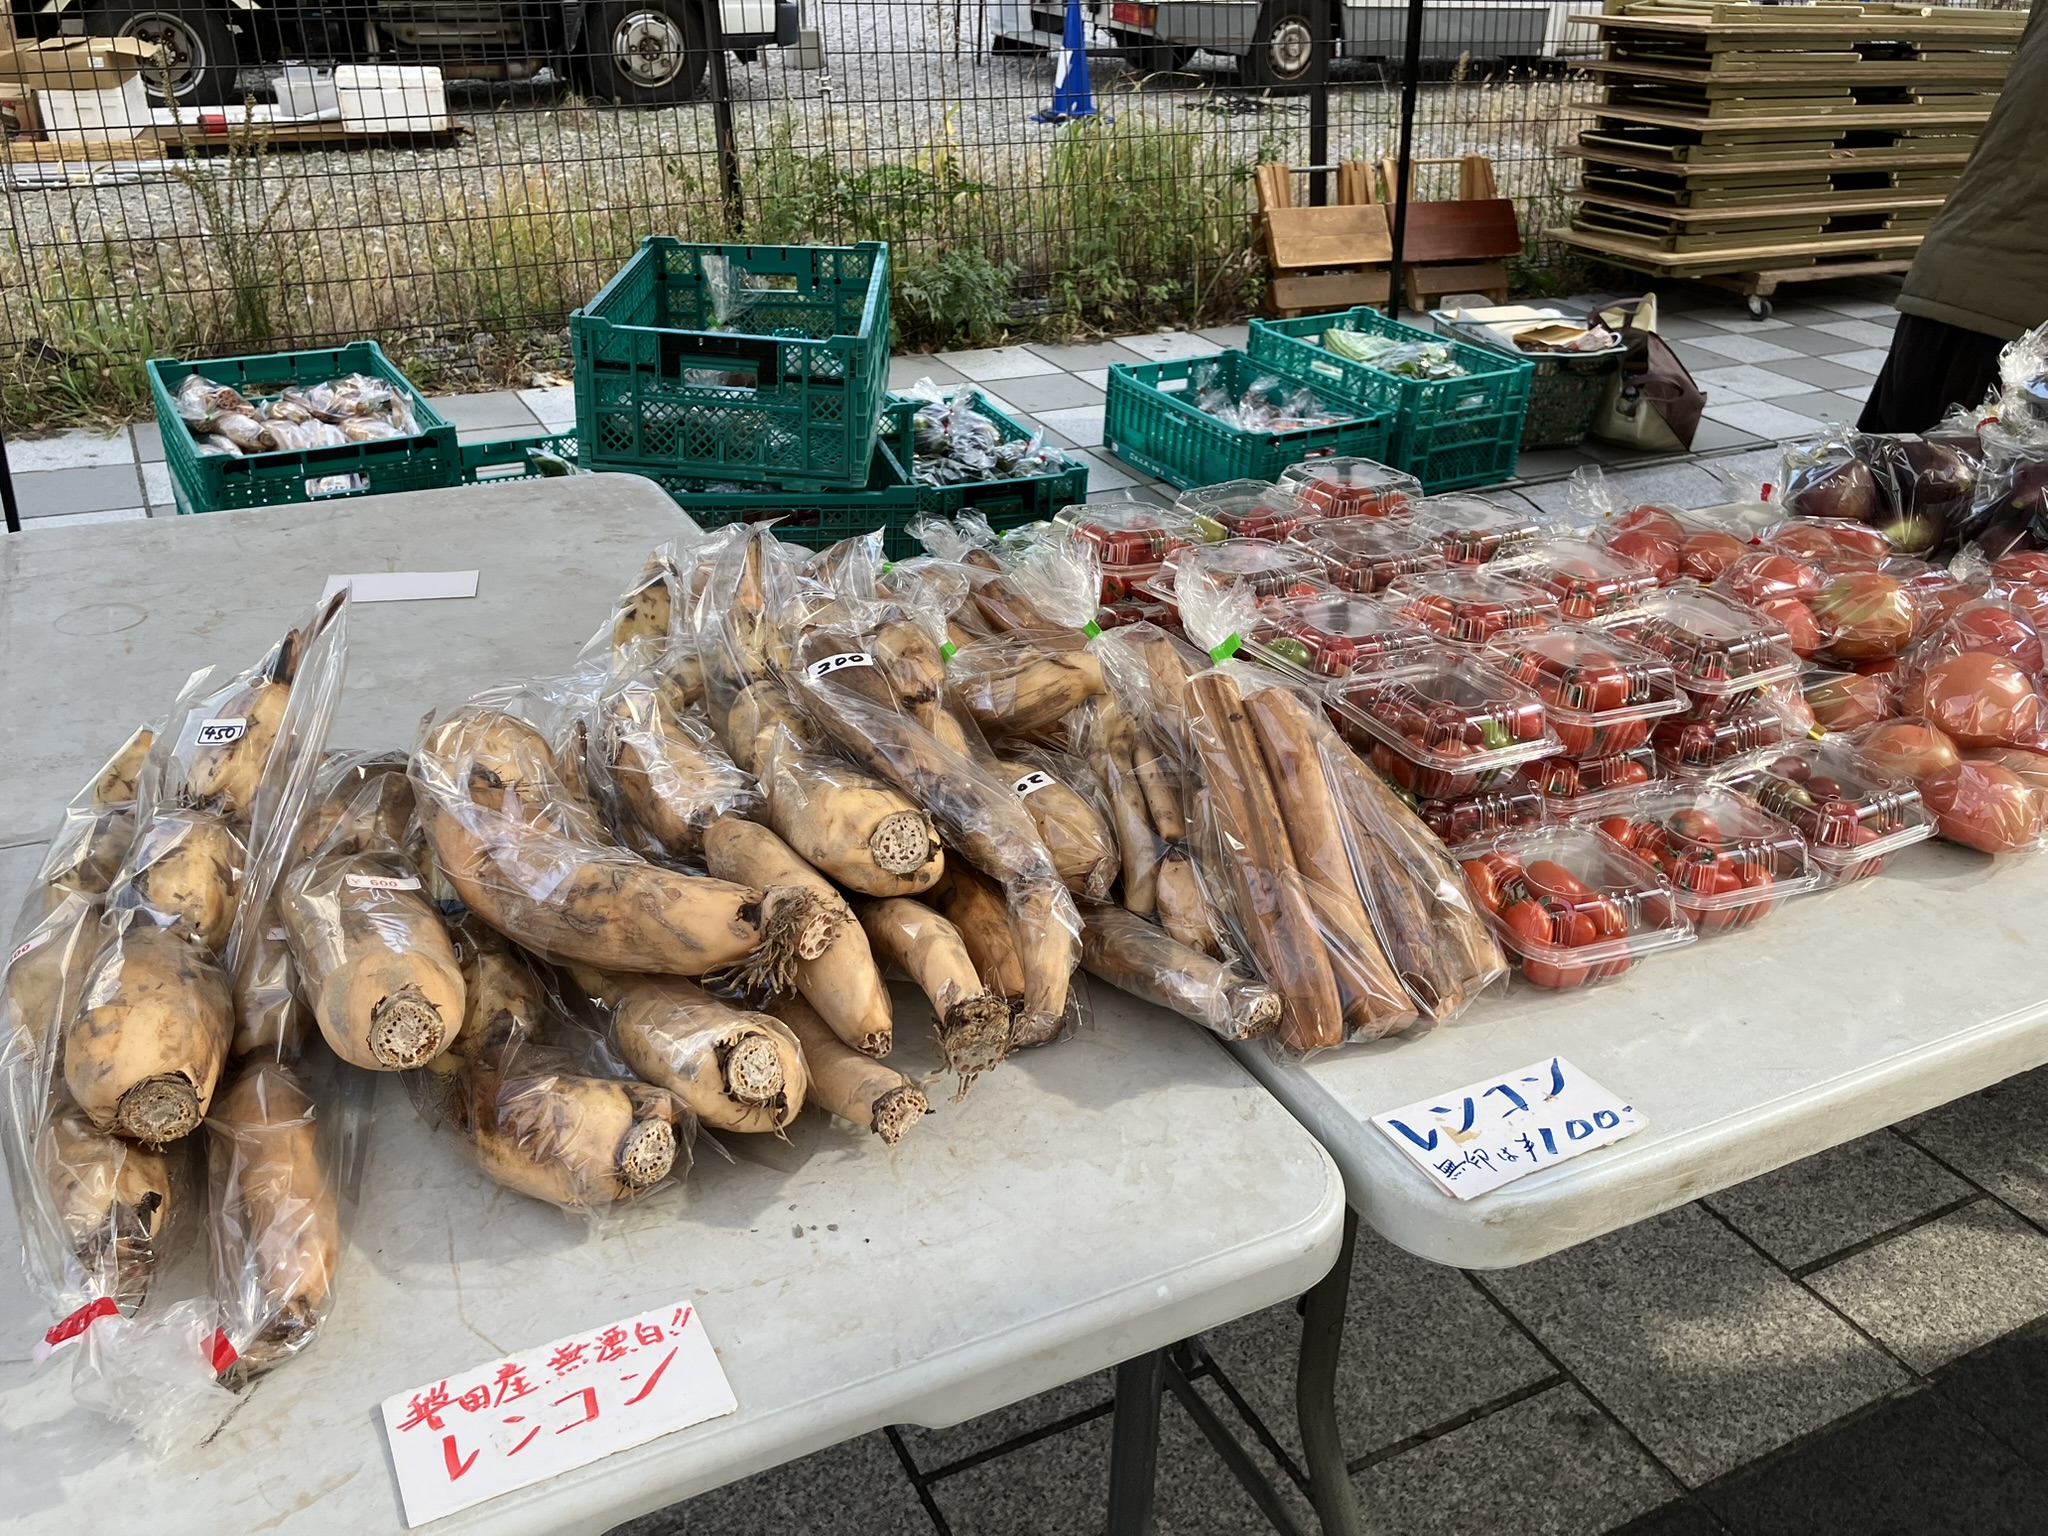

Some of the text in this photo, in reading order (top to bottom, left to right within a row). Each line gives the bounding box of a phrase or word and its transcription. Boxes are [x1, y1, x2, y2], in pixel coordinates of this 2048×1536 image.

[817, 655, 864, 675] 200
[204, 726, 236, 740] 450
[1015, 773, 1044, 798] 20
[370, 879, 398, 887] 600
[1387, 1057, 1565, 1151] レンコン
[442, 1346, 678, 1482] レンコン
